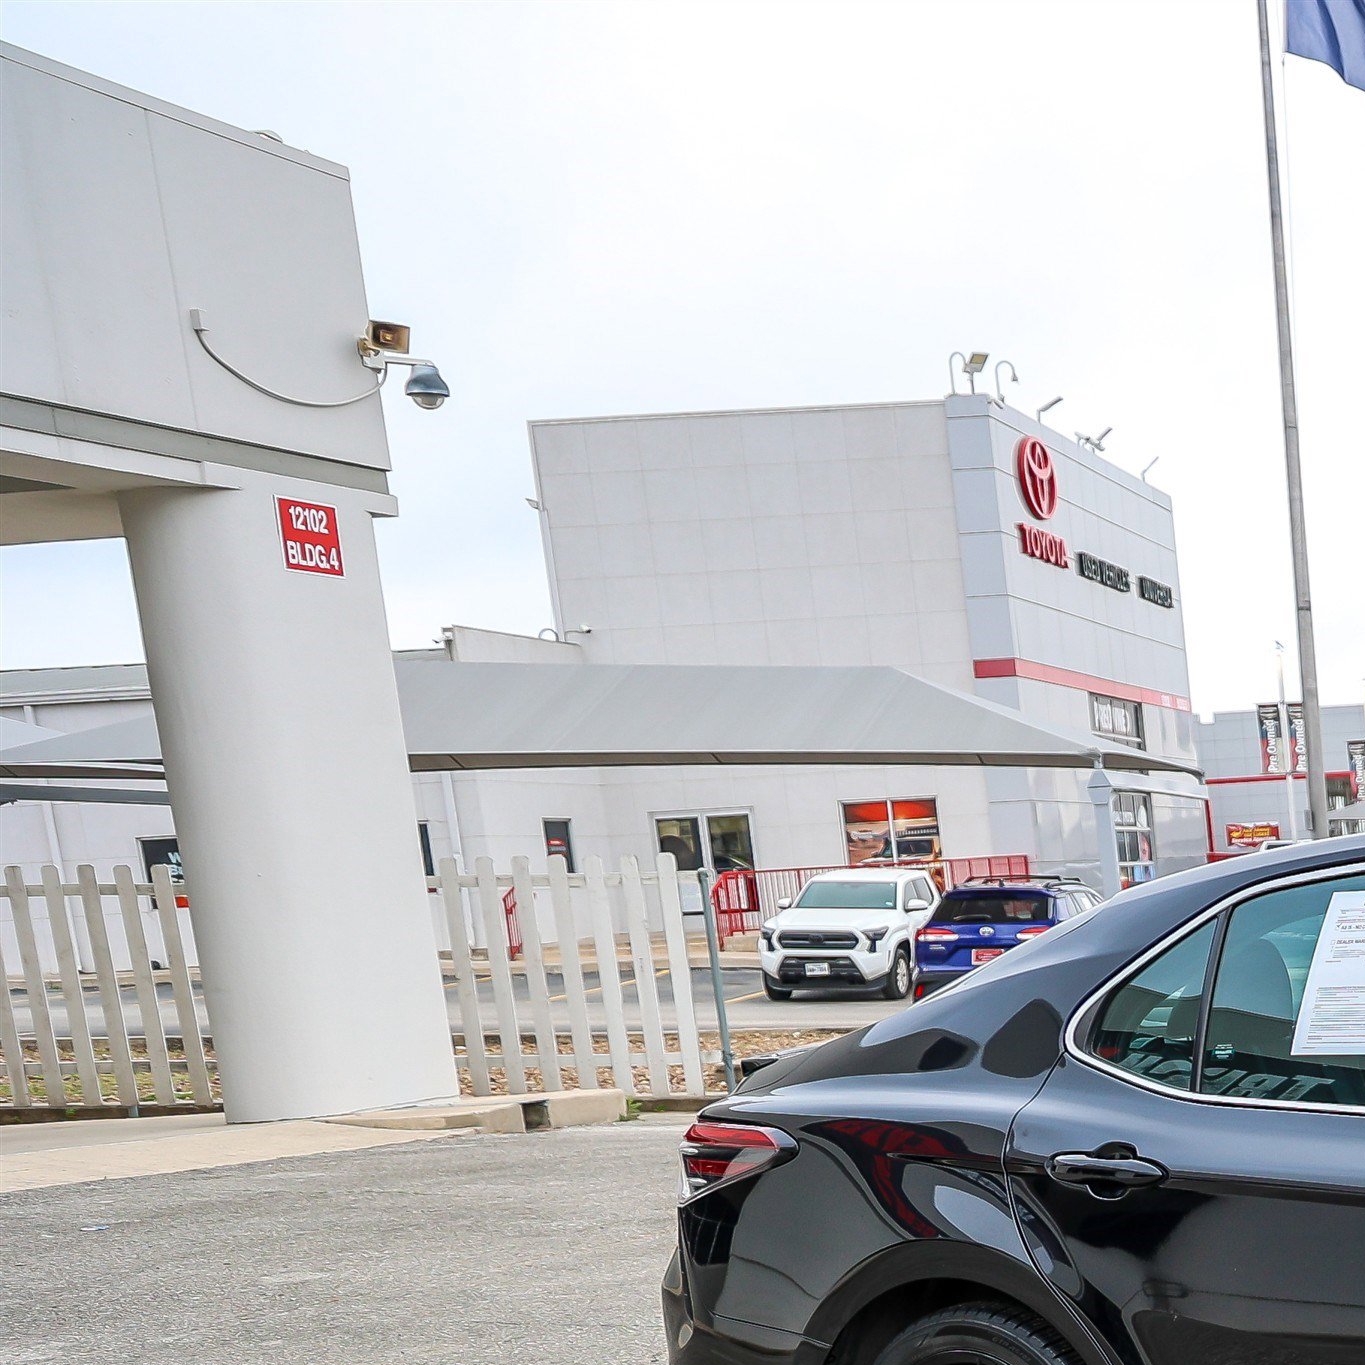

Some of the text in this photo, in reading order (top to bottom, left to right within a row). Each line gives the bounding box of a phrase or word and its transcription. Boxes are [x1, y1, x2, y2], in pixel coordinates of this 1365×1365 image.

[289, 505, 329, 534] 12102
[1019, 522, 1069, 569] TOYOTA
[1263, 719, 1277, 754] Owned
[1292, 719, 1308, 772] Pre Owned
[1268, 755, 1279, 772] Pre
